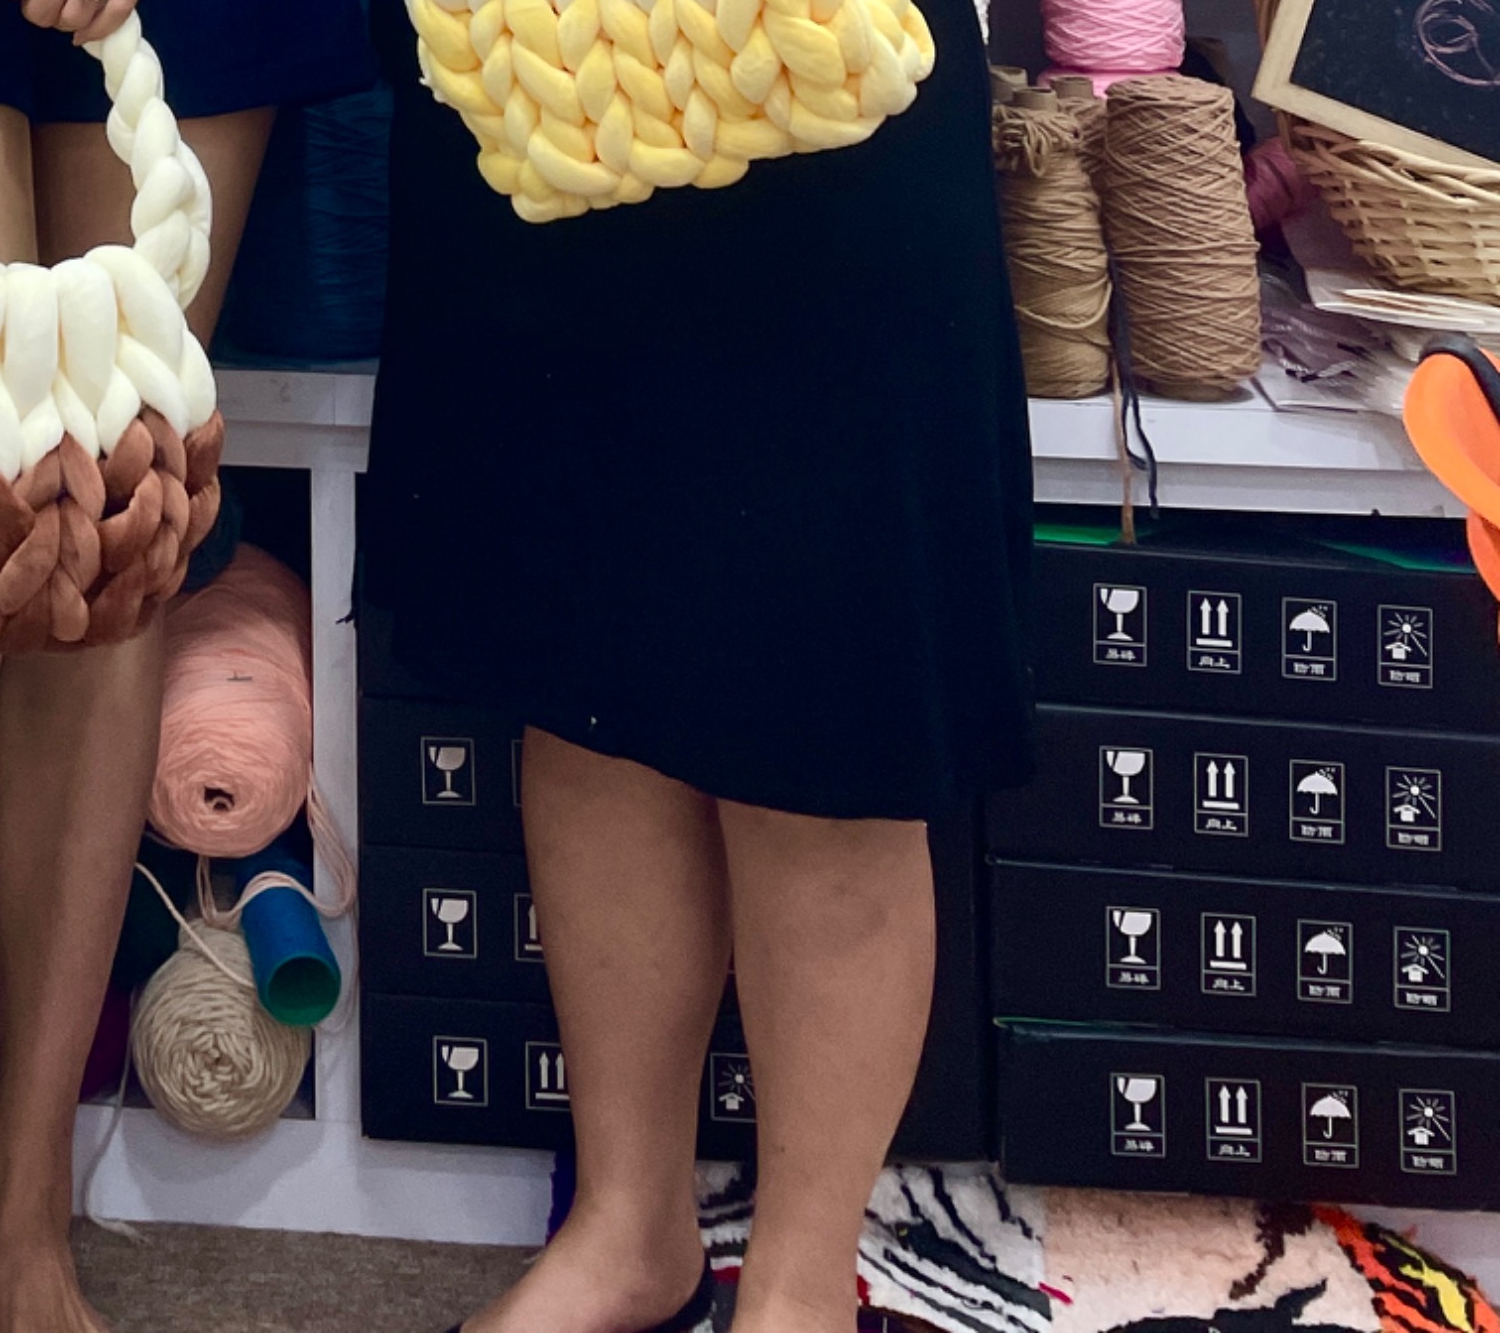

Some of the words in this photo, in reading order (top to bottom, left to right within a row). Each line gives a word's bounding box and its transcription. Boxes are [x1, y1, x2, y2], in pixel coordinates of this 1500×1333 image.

[1198, 655, 1231, 669] 向上
[1205, 818, 1238, 832] 向上
[1212, 977, 1245, 991] 向上
[1218, 1143, 1251, 1158] 向上
